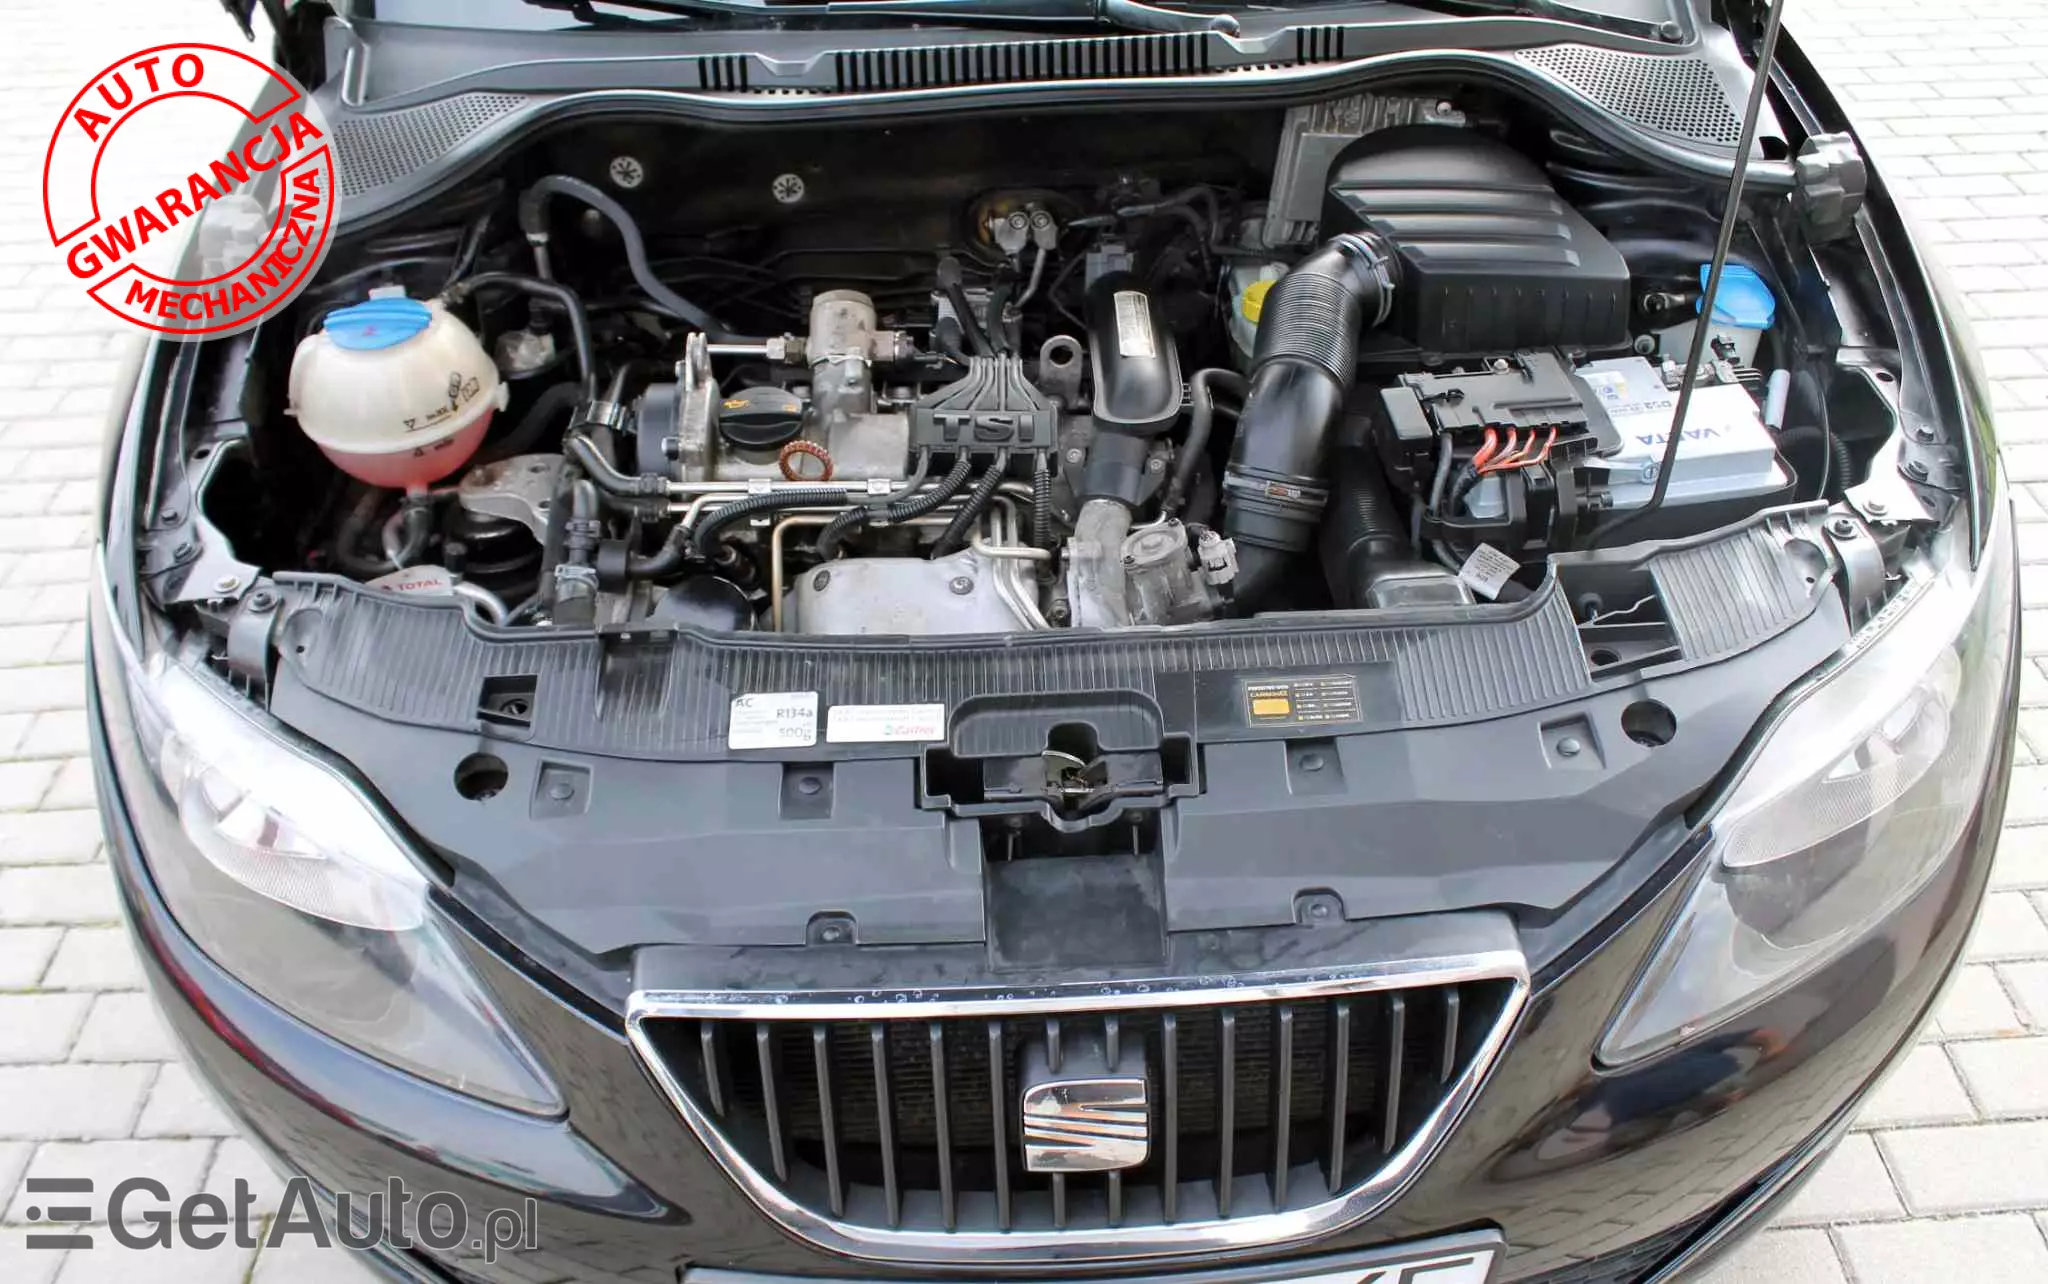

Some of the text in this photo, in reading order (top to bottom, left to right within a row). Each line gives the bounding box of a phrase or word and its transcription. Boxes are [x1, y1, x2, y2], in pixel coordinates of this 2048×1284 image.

[932, 413, 1035, 443] TSI
[1635, 428, 1720, 445] VATA
[398, 579, 443, 591] TOTAL
[735, 698, 753, 708] AC
[776, 707, 813, 719] R134a
